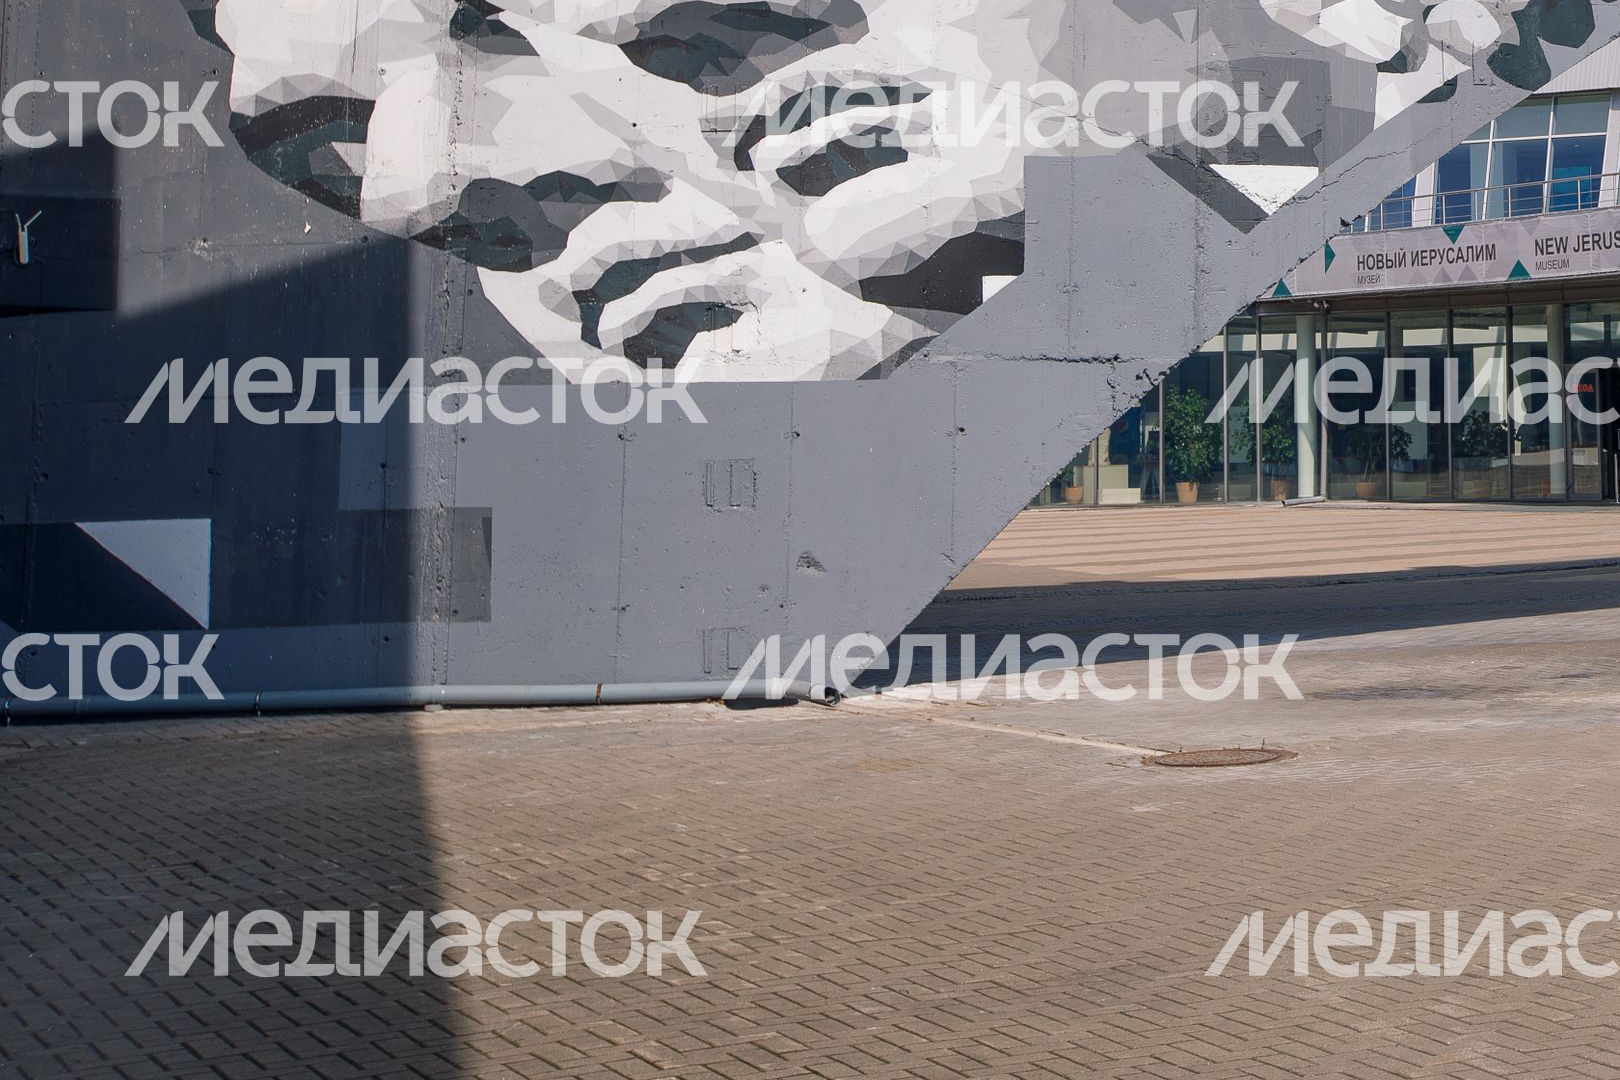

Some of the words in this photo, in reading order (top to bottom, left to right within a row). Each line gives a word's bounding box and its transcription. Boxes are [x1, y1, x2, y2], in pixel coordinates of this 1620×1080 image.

[1534, 236, 1569, 257] NEW
[1357, 248, 1407, 271] НОВЫЙ
[1411, 244, 1497, 267] ИЕРУСАЛИМ
[1535, 258, 1570, 271] MUSEUM
[1357, 274, 1381, 284] МУЗЕЙ
